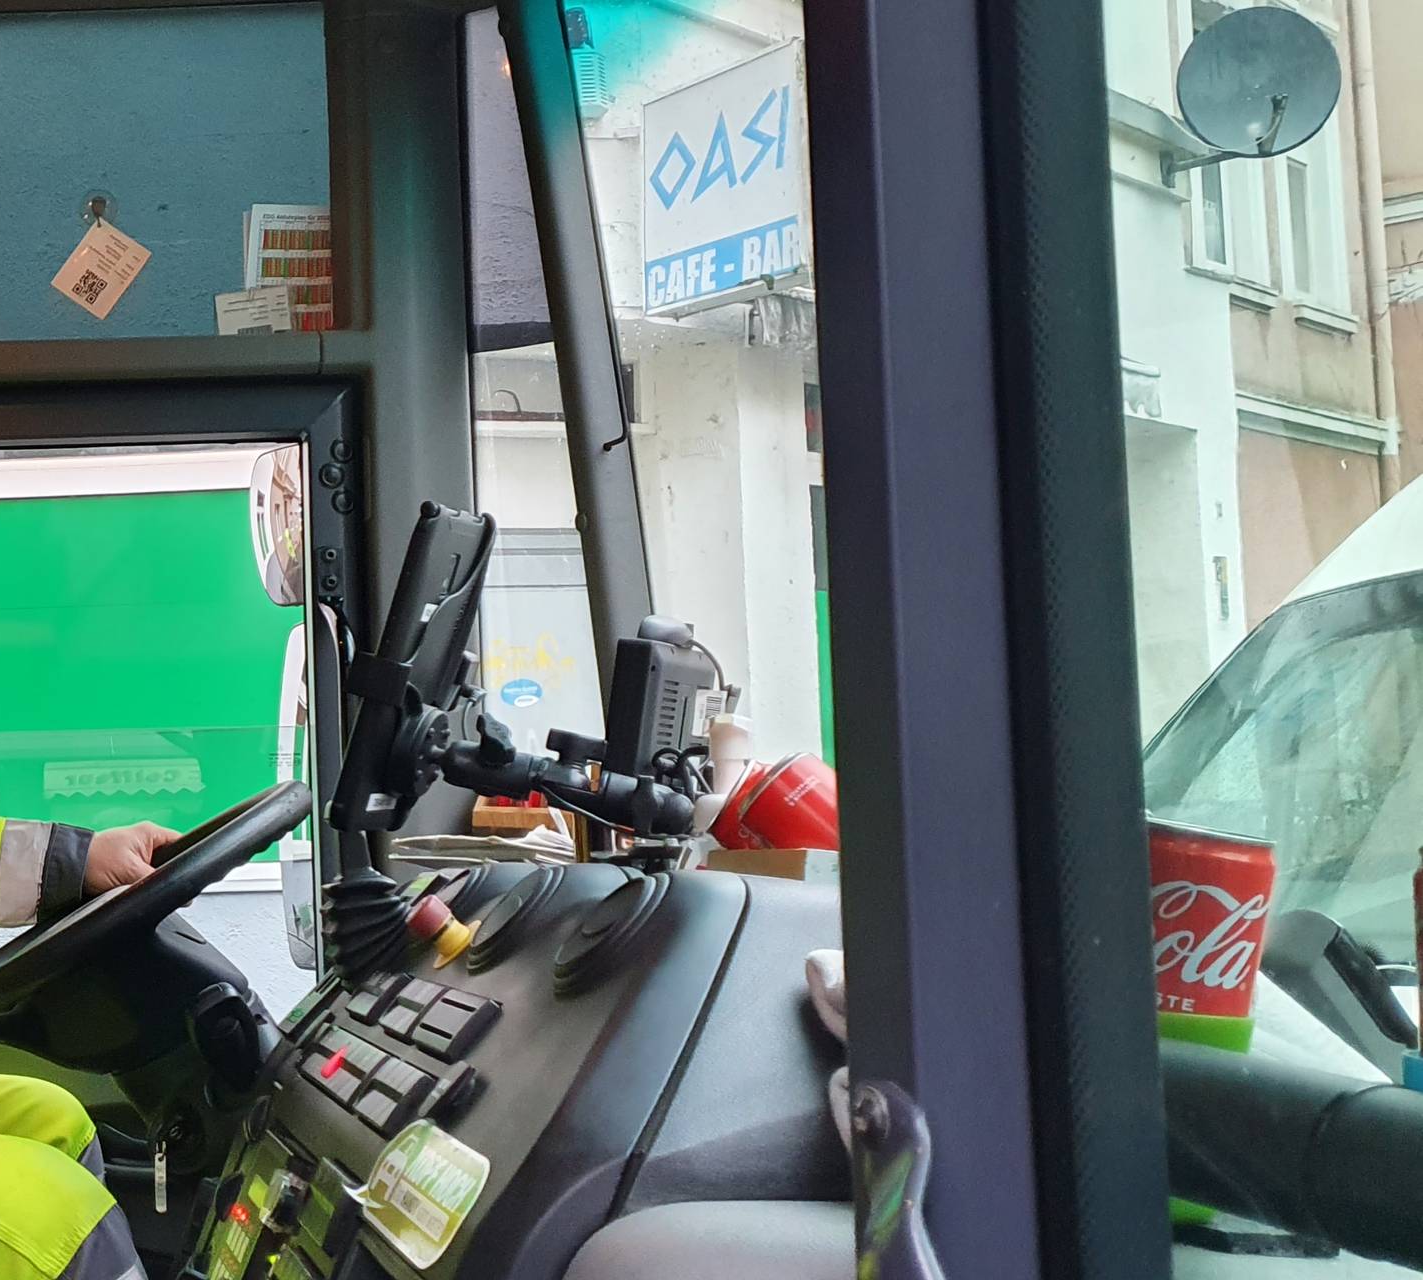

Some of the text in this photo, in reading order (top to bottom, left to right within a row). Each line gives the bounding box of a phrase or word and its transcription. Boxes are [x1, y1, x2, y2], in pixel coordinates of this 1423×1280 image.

[649, 85, 790, 210] OASI
[647, 248, 717, 308] CAFE
[742, 224, 801, 280] BAR
[1156, 991, 1196, 1012] STE
